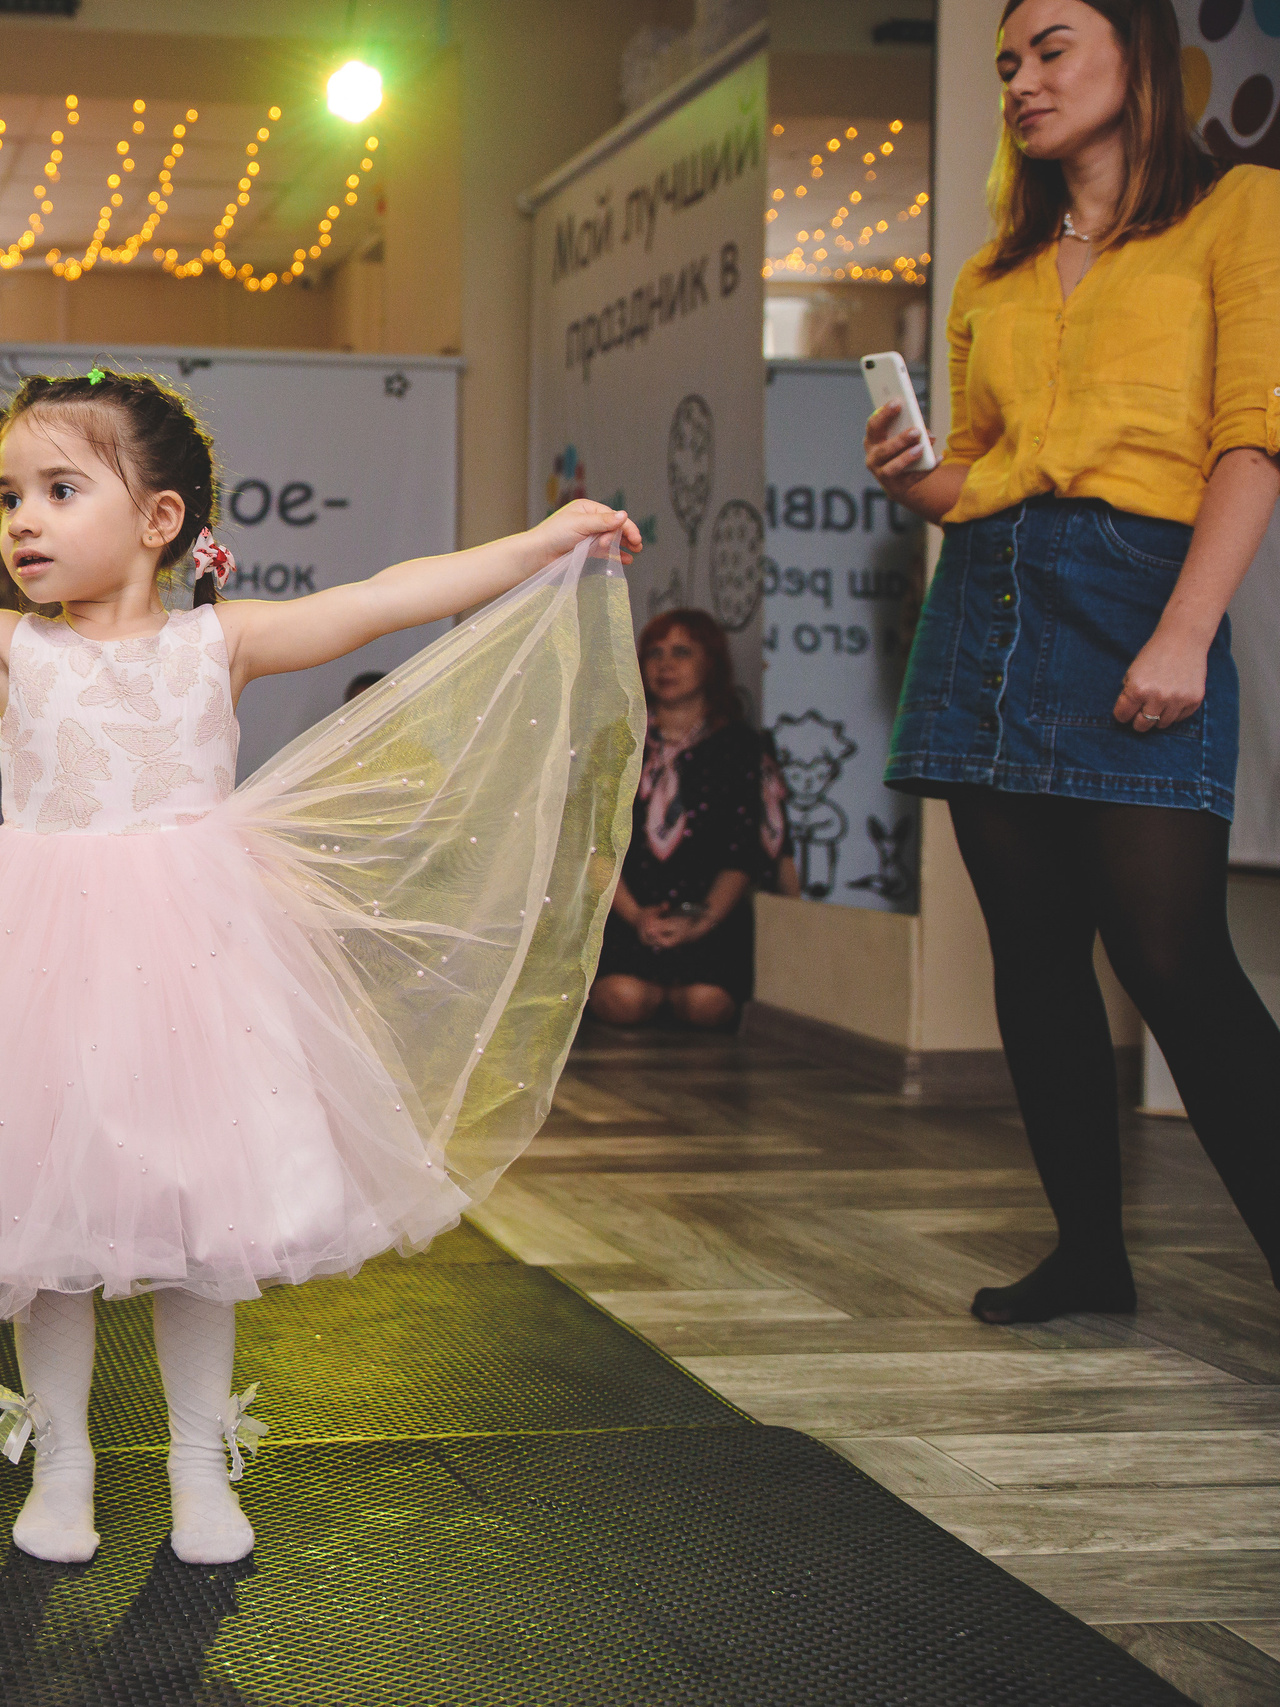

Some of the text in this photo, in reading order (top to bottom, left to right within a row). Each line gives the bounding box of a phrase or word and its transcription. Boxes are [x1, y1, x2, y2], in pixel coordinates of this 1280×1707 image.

[552, 86, 762, 285] Мой лучший
[564, 254, 710, 384] праздник
[230, 479, 348, 526] ое-
[212, 562, 318, 595] нок
